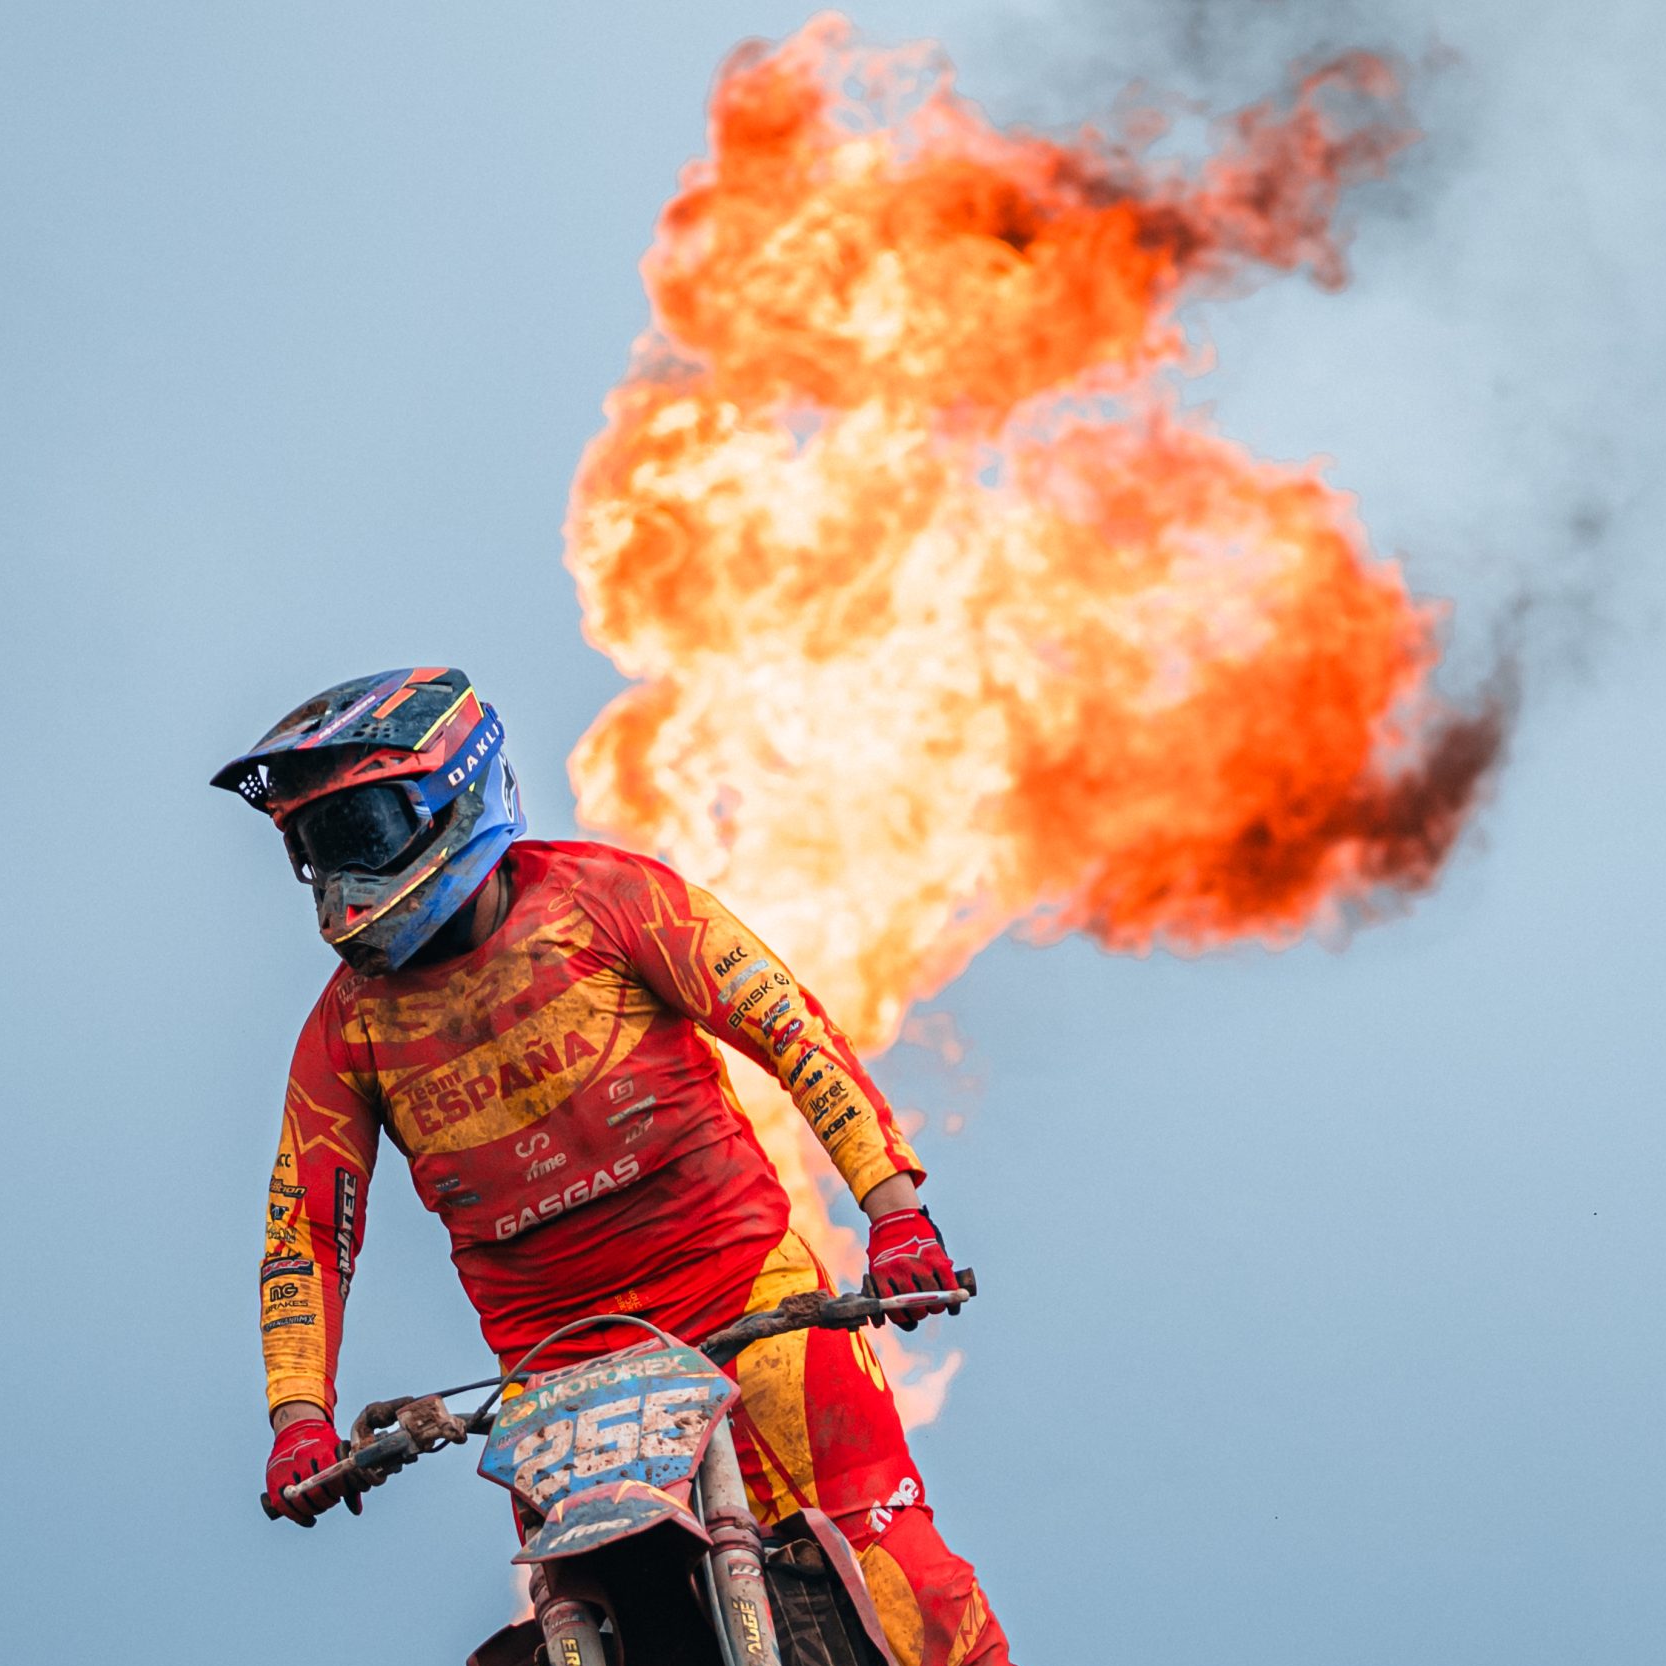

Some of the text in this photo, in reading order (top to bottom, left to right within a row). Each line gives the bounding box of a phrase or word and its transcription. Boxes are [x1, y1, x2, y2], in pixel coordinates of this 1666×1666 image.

[714, 946, 748, 977] RACC
[728, 980, 773, 1028] BRISK
[403, 1068, 462, 1105] Team
[410, 1030, 599, 1136] ESPAÑA
[810, 1080, 846, 1114] lloret
[495, 1153, 640, 1240] GASGAS
[538, 1354, 687, 1410] MOTOREX
